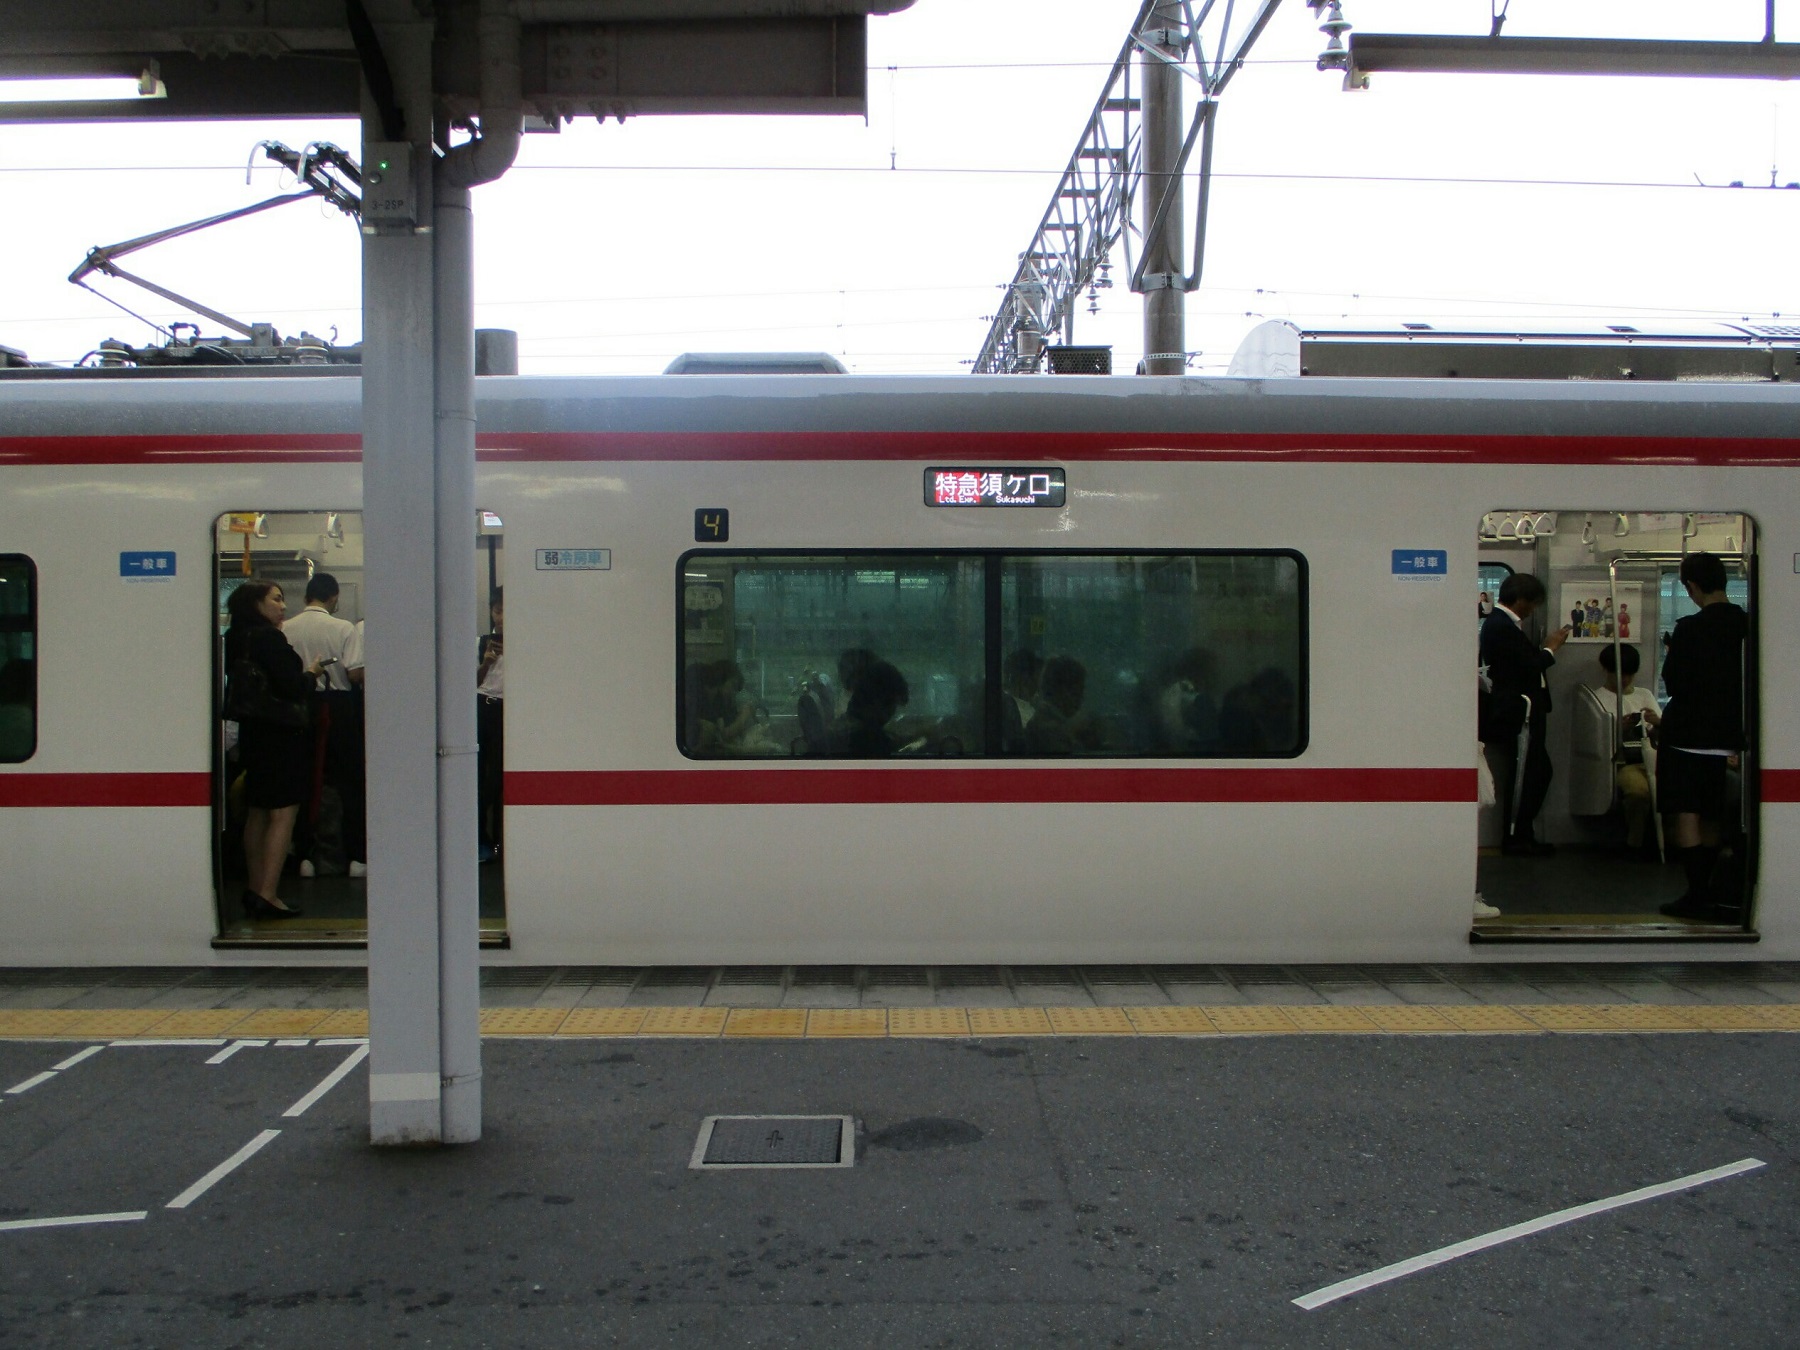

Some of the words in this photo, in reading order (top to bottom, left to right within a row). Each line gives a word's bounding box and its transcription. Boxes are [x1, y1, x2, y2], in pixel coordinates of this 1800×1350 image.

[938, 495, 957, 503] Ltd.
[958, 495, 977, 503] Exp.
[995, 495, 1035, 504] Sukaguchi
[703, 514, 720, 536] 4
[129, 558, 168, 570] 一般車
[544, 551, 602, 566] 弱冷房車
[1400, 556, 1439, 568] 一般車
